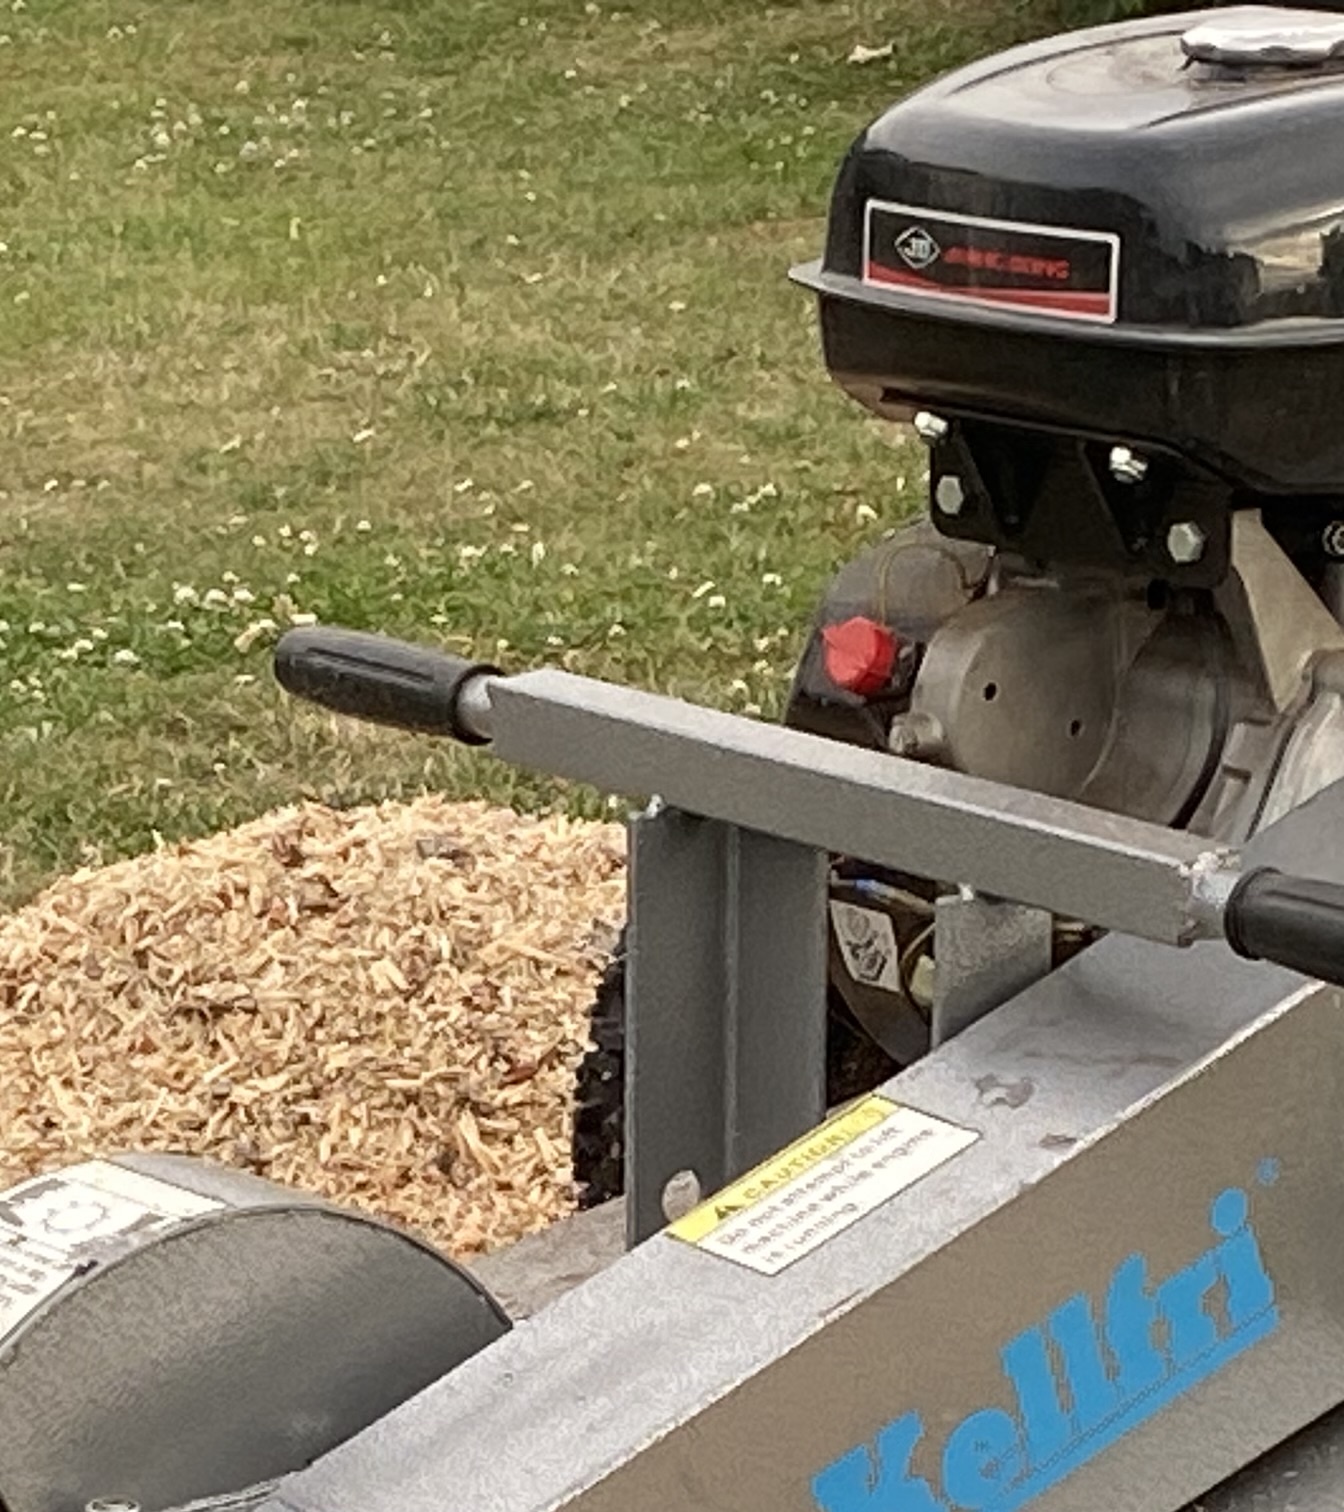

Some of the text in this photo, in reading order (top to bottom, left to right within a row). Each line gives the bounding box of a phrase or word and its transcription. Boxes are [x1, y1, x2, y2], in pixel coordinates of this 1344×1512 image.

[719, 1228, 750, 1245] Do
[743, 1204, 784, 1228] not
[776, 1156, 858, 1206] attempt
[737, 1127, 937, 1254] machine while engine
